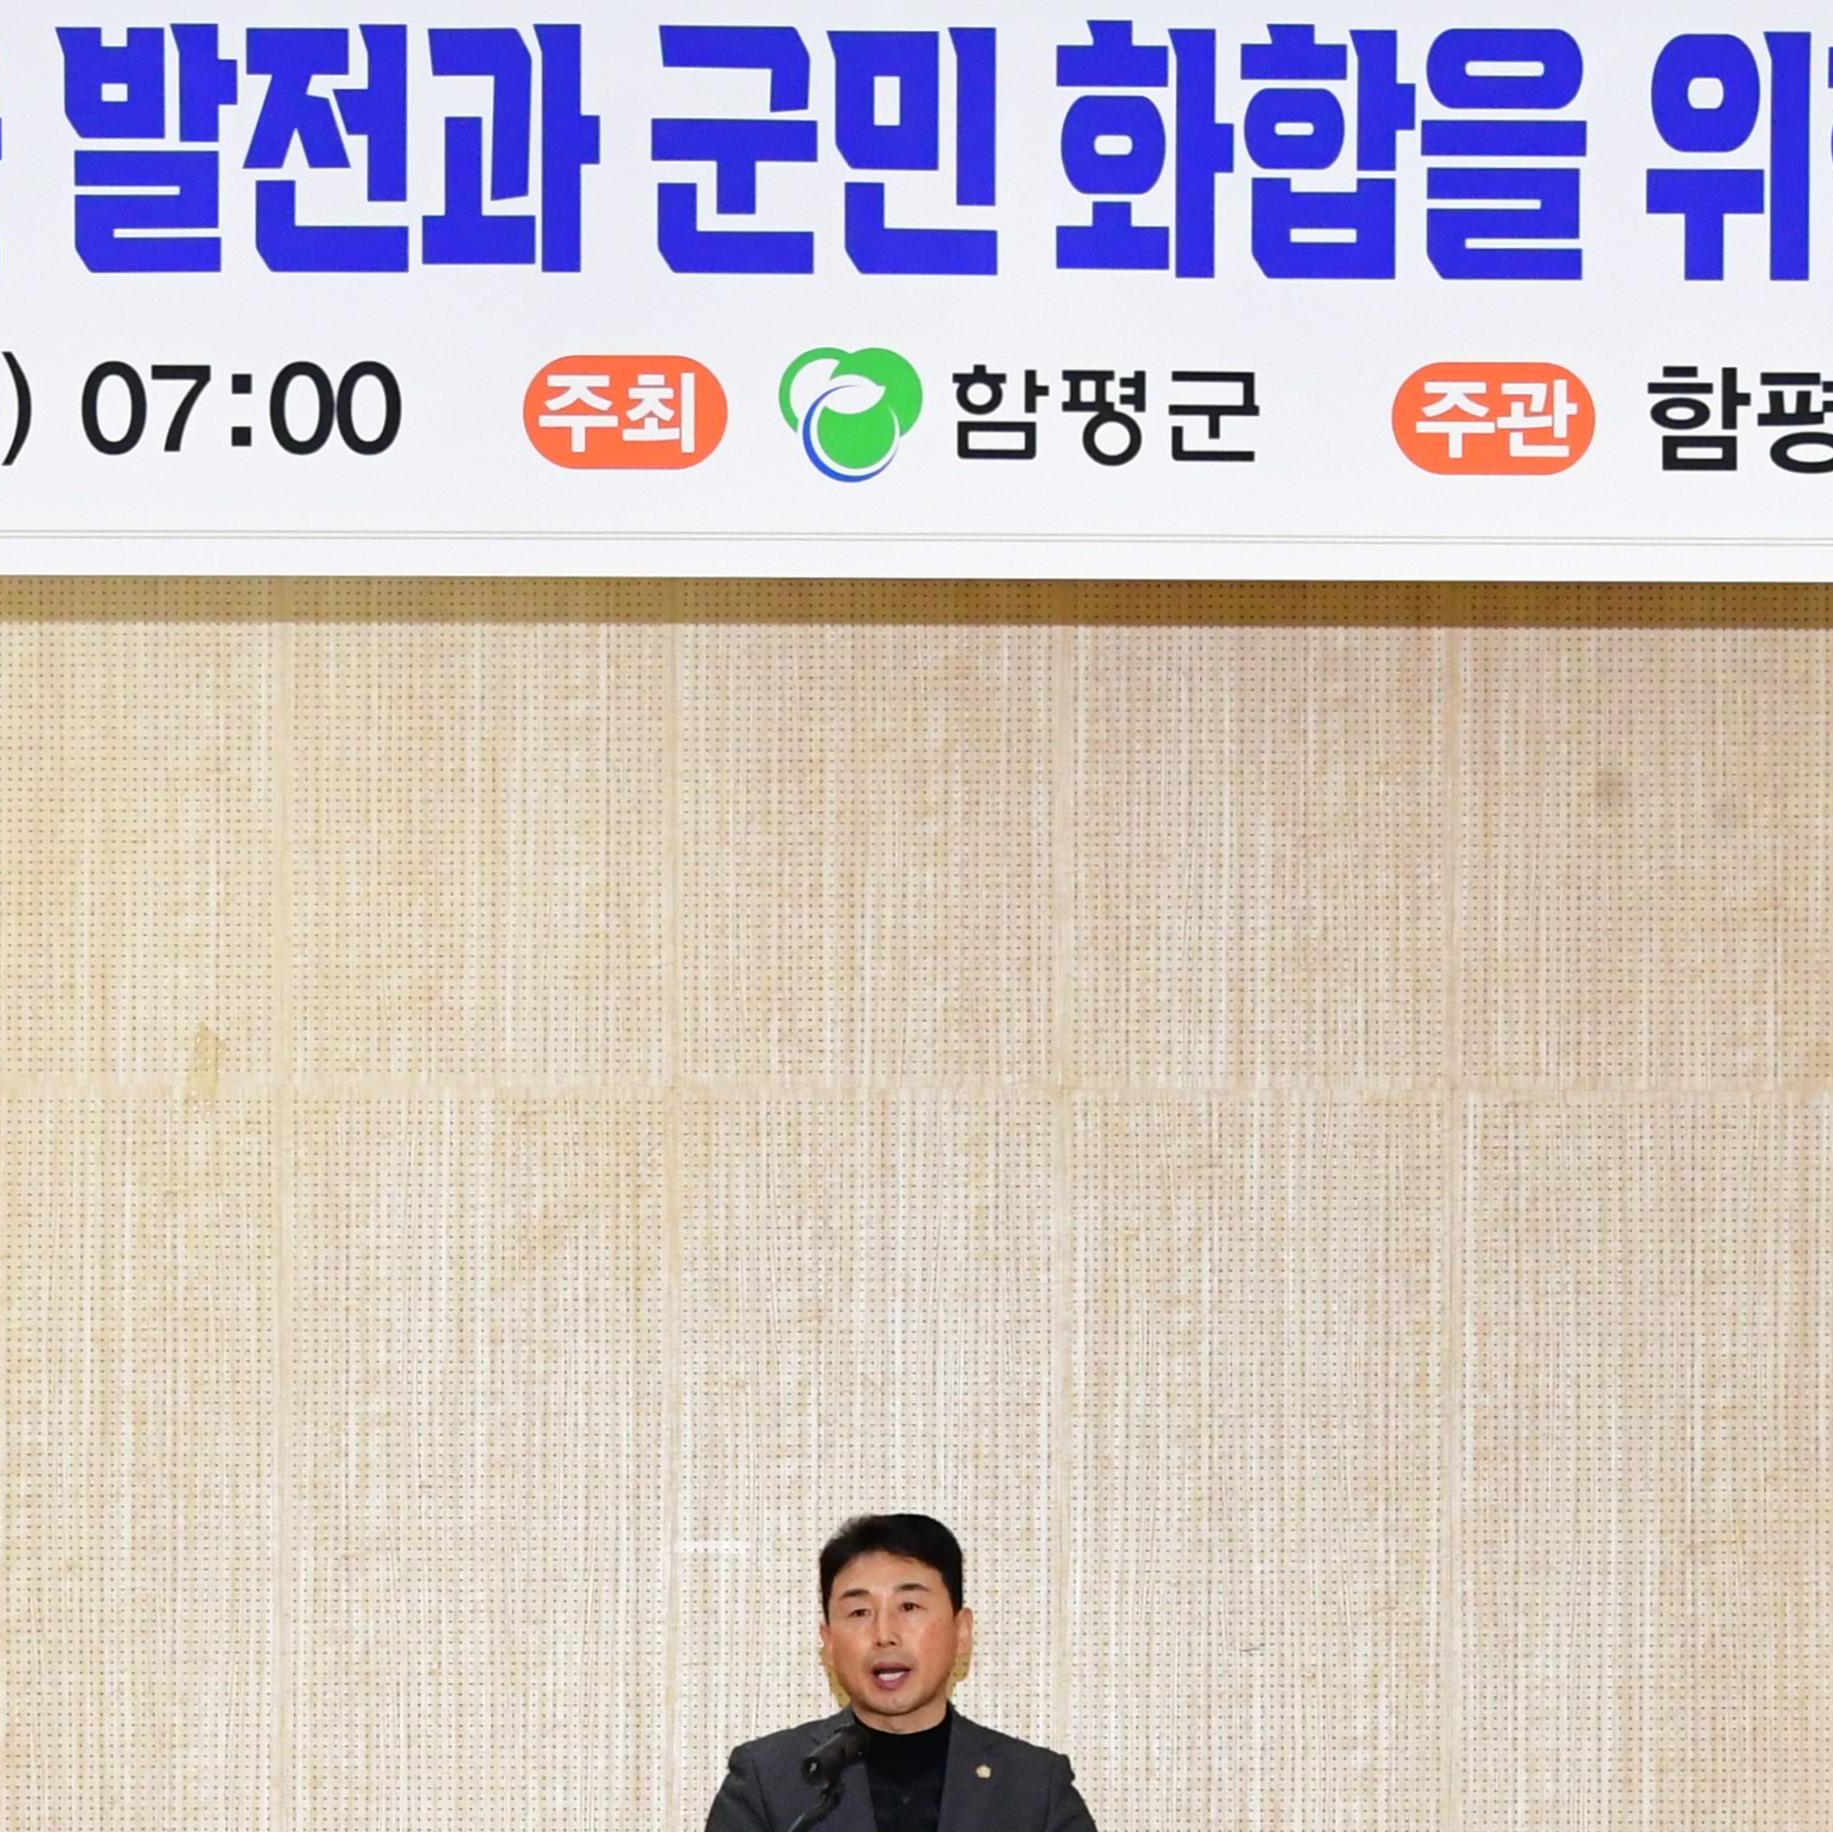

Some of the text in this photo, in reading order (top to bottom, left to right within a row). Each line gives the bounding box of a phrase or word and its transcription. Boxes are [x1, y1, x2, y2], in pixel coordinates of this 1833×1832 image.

[56, 23, 601, 275] 발전과
[651, 25, 998, 276] 군민
[1056, 20, 1588, 281] 화합을
[81, 361, 403, 456] 07:00
[536, 364, 1261, 467] 주최 함평군
[1413, 378, 1577, 460] 주관
